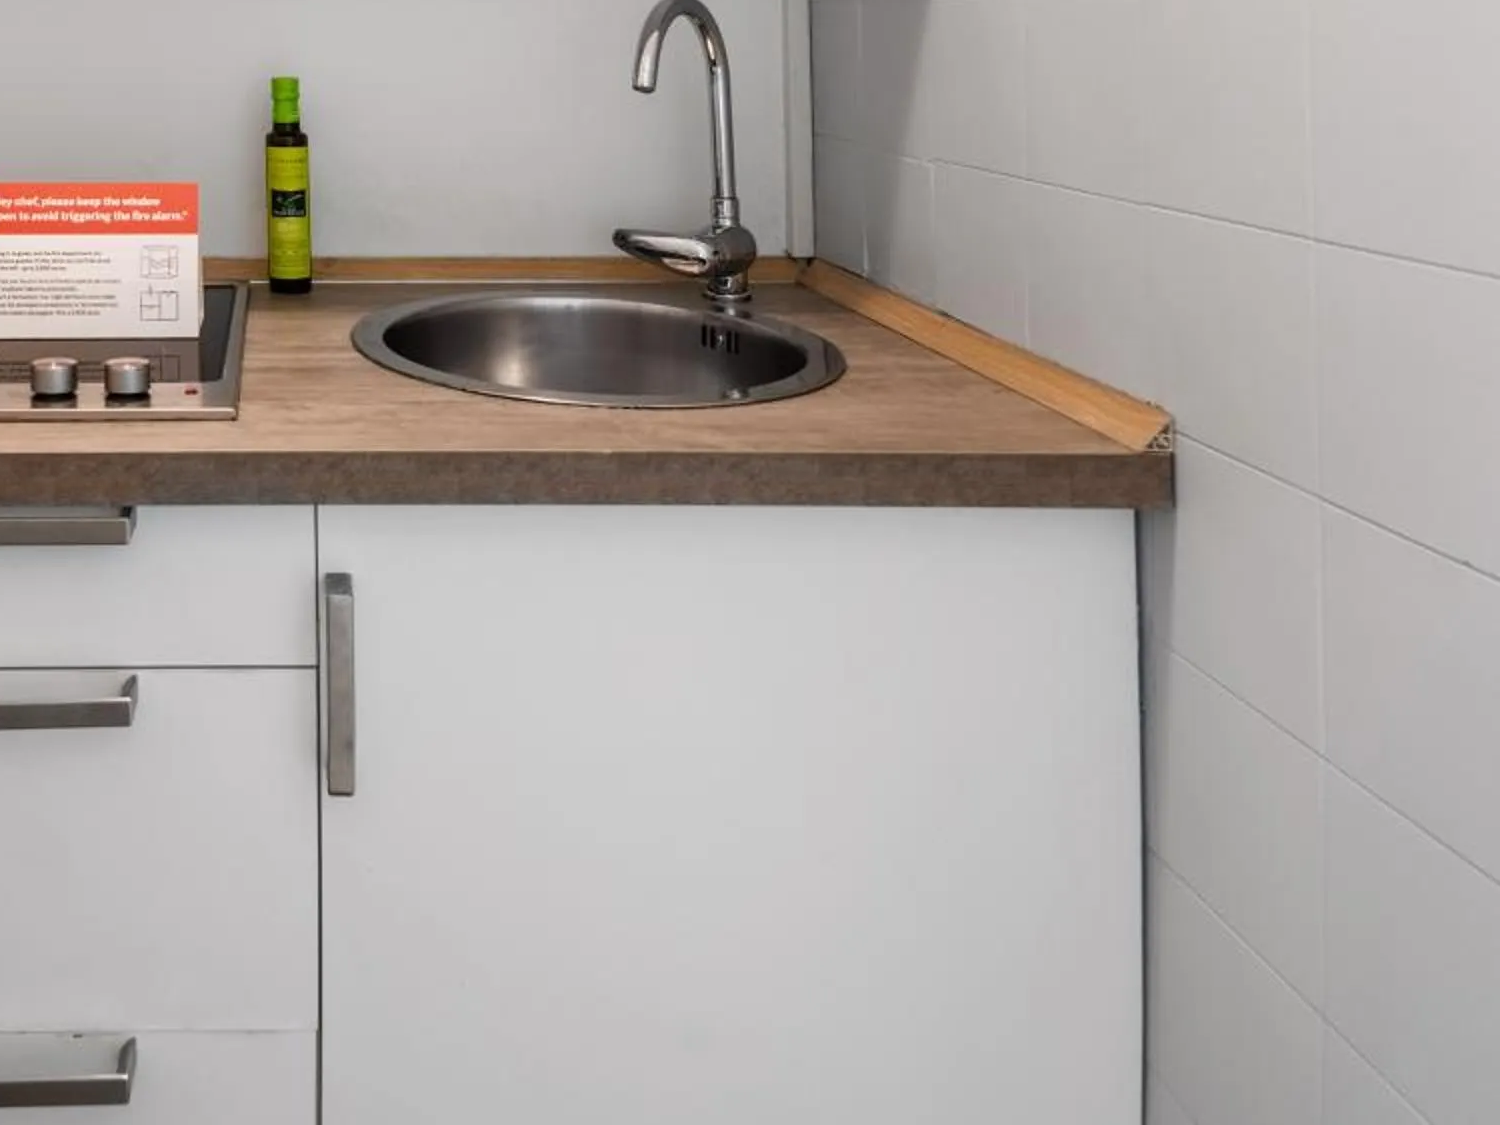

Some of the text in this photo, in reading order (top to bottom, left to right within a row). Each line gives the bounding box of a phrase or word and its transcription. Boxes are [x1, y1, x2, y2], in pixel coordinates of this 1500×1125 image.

[42, 195, 75, 209] please
[76, 195, 101, 209] keep
[103, 195, 121, 207] the
[122, 195, 162, 207] window
[19, 211, 30, 221] to
[31, 210, 59, 221] avoid
[61, 210, 111, 223] triggering
[113, 210, 131, 221] the
[132, 210, 150, 221] fire
